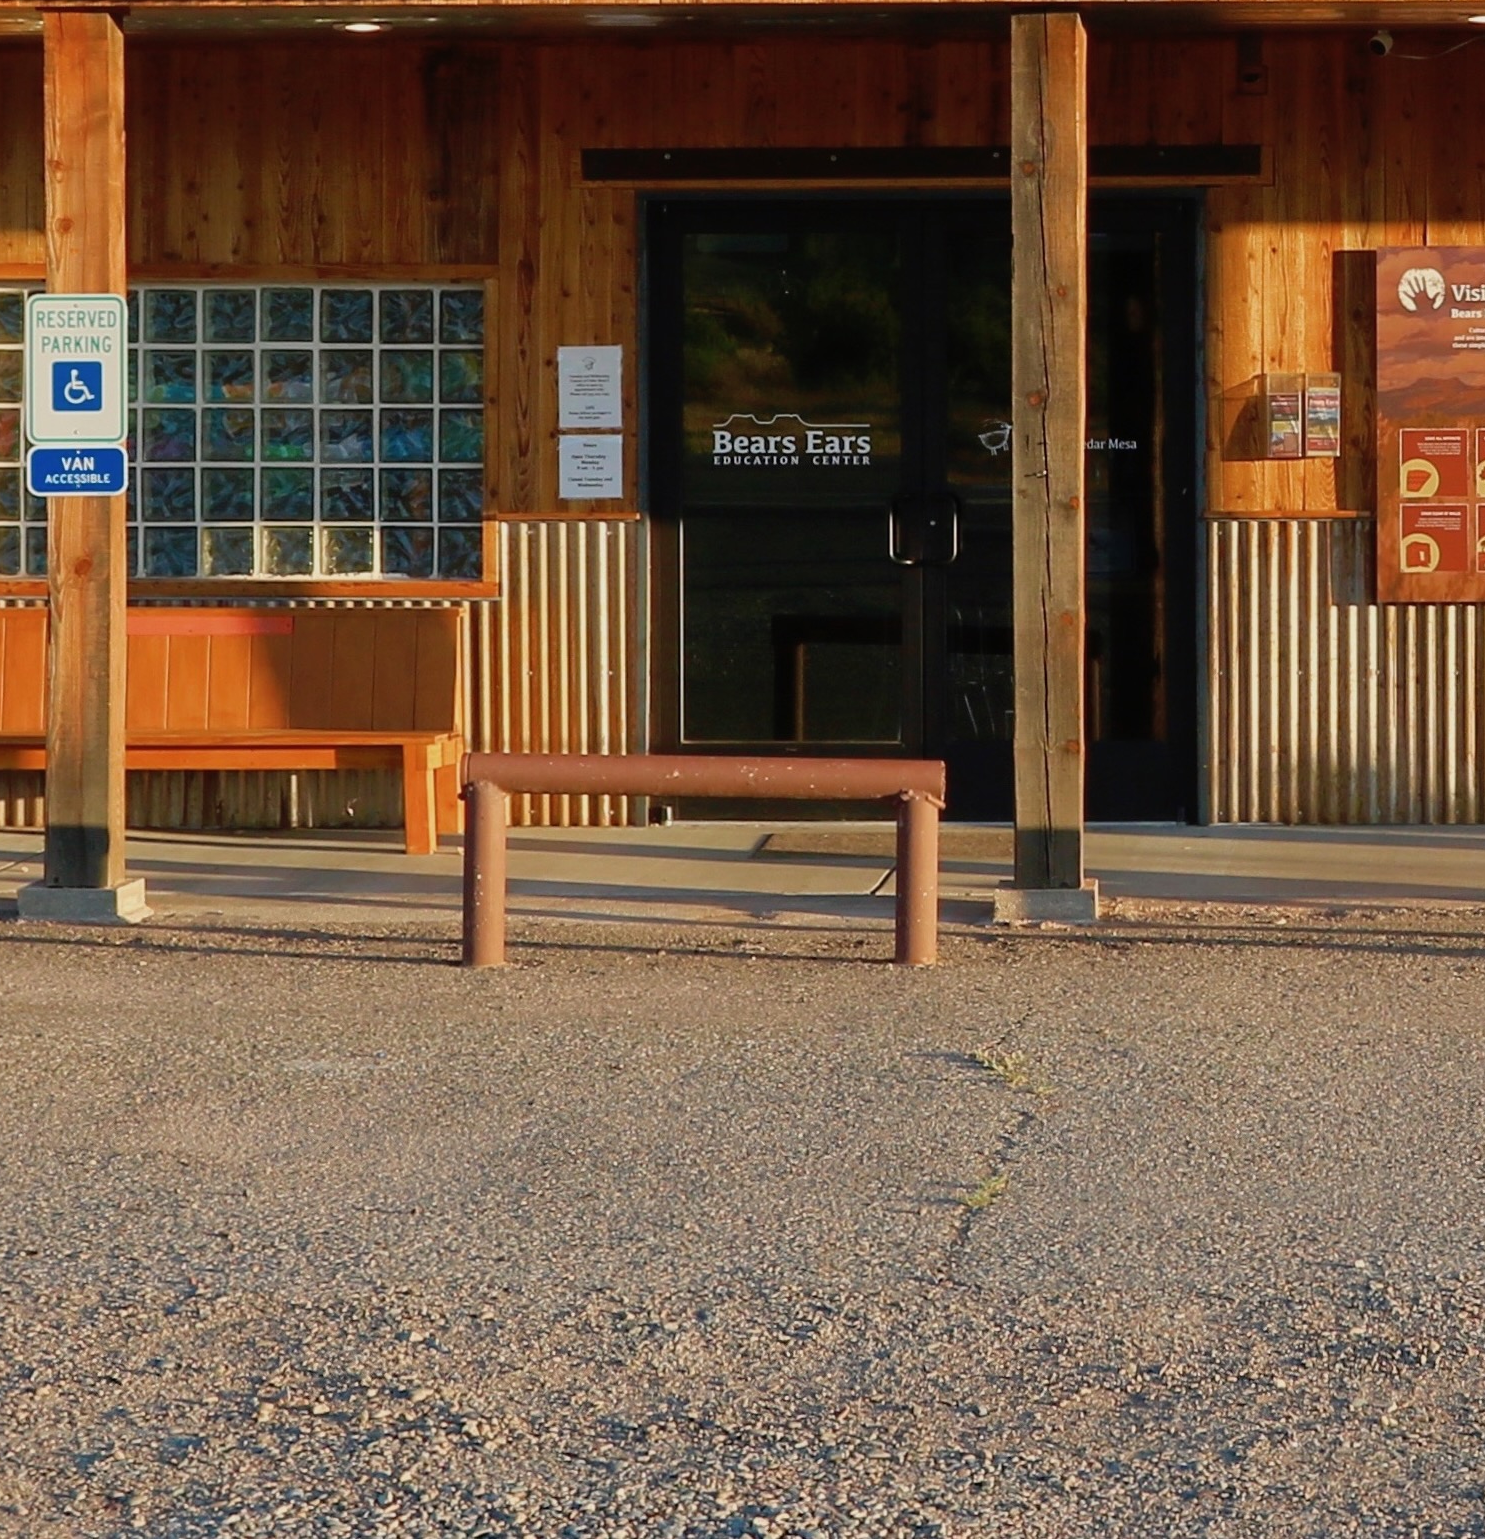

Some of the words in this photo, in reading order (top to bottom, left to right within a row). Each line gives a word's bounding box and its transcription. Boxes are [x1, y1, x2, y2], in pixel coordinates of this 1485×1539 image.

[36, 311, 117, 328] RESERVED
[1451, 308, 1482, 318] Bears
[41, 336, 112, 353] PARKING
[712, 430, 796, 454] Bears
[805, 430, 871, 454] Ears
[1084, 438, 1104, 449] dar
[1108, 438, 1137, 450] Mesa
[62, 457, 95, 471] VAN
[713, 456, 799, 465] EDUCATION
[813, 456, 870, 465] CENTER
[45, 474, 110, 484] ACCESSIBLE
